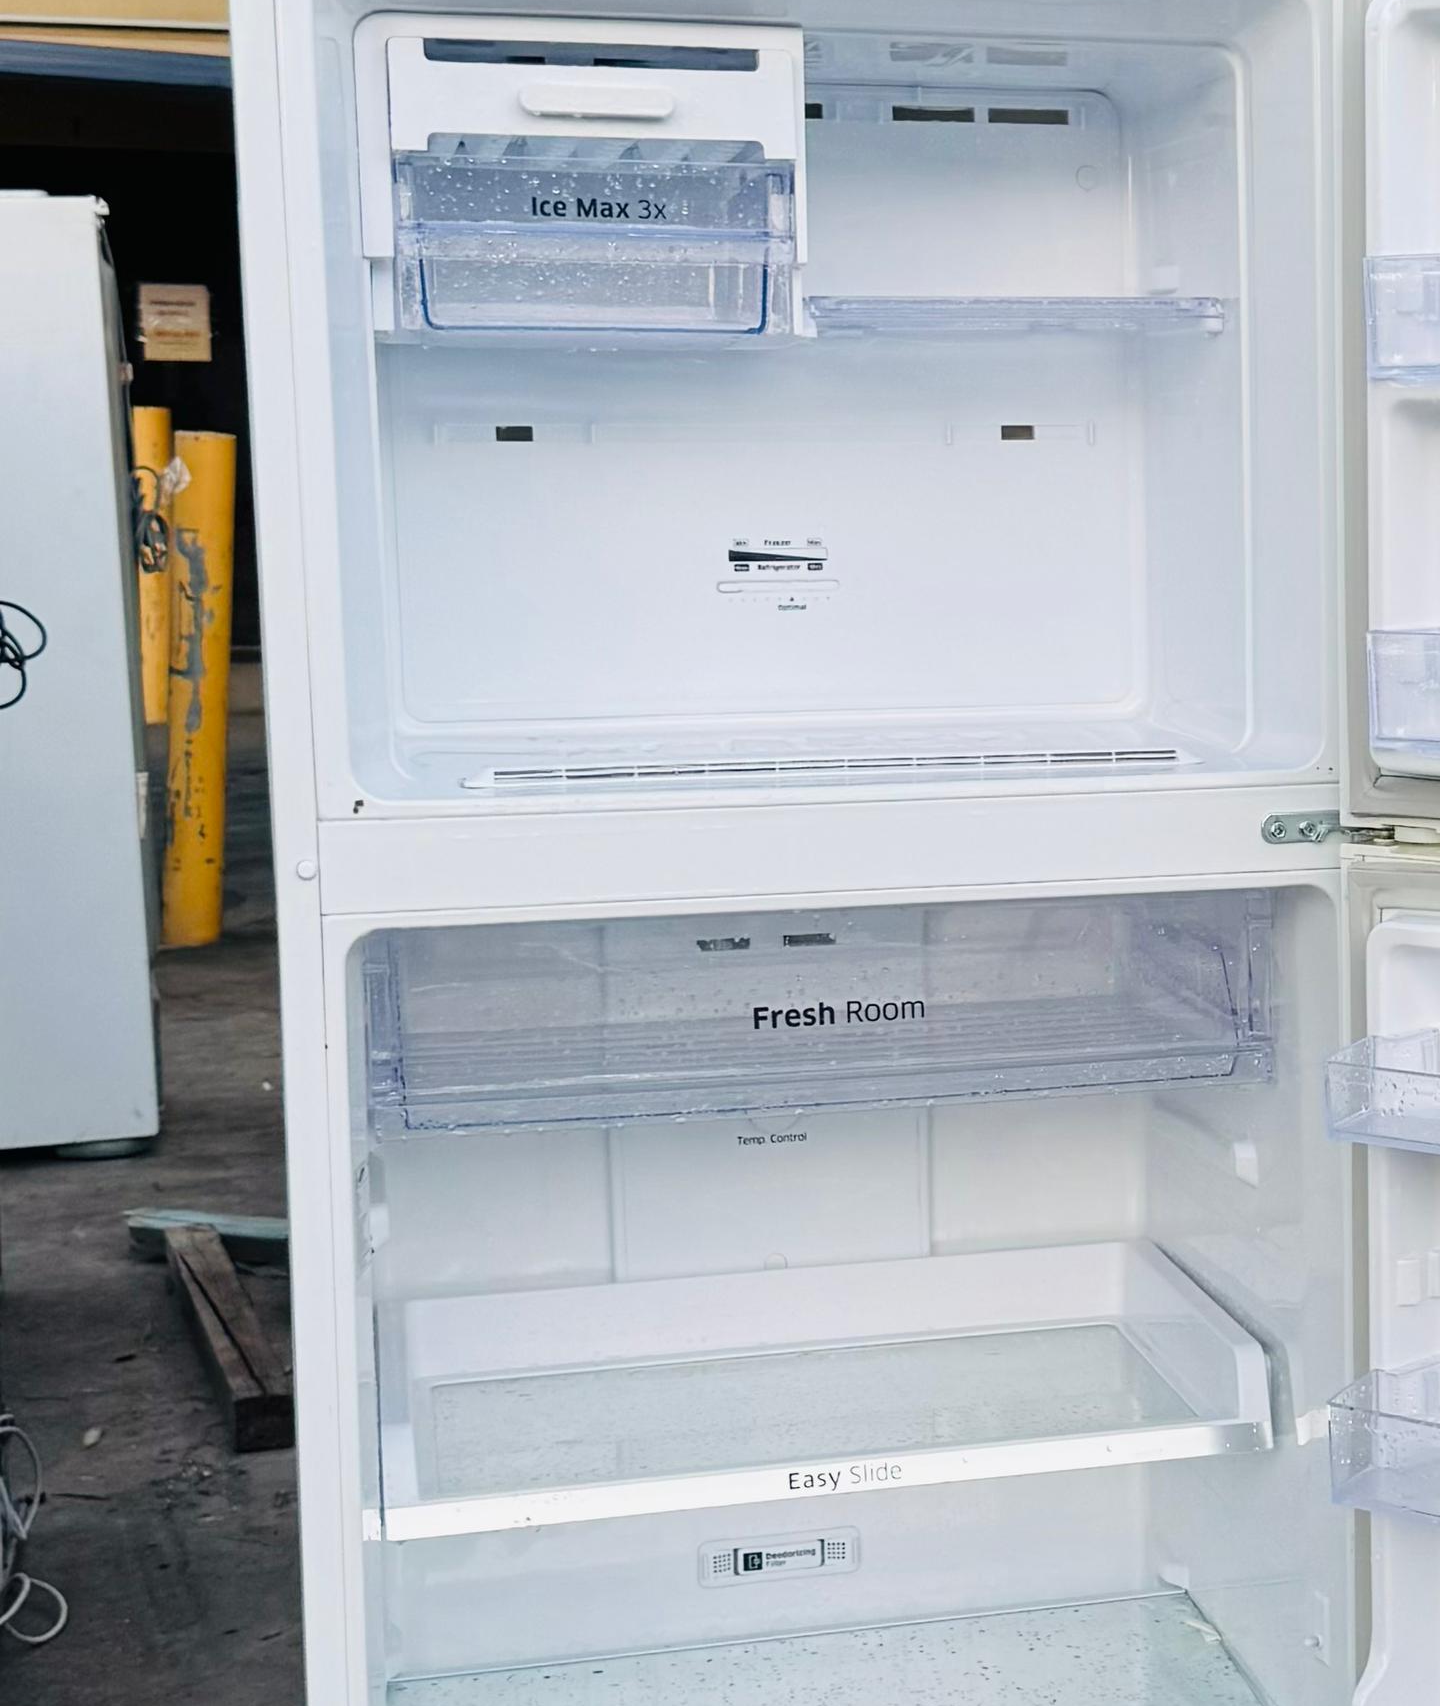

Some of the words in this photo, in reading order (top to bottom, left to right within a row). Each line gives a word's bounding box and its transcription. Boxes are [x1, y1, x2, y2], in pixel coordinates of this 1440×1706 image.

[531, 195, 567, 218] Ice
[576, 197, 630, 219] Max
[637, 198, 668, 220] 3x
[752, 1001, 836, 1030] Fresh
[846, 999, 925, 1024] Room
[770, 1132, 808, 1143] Control
[788, 1471, 842, 1492] Easy
[849, 1462, 903, 1485] Slide
